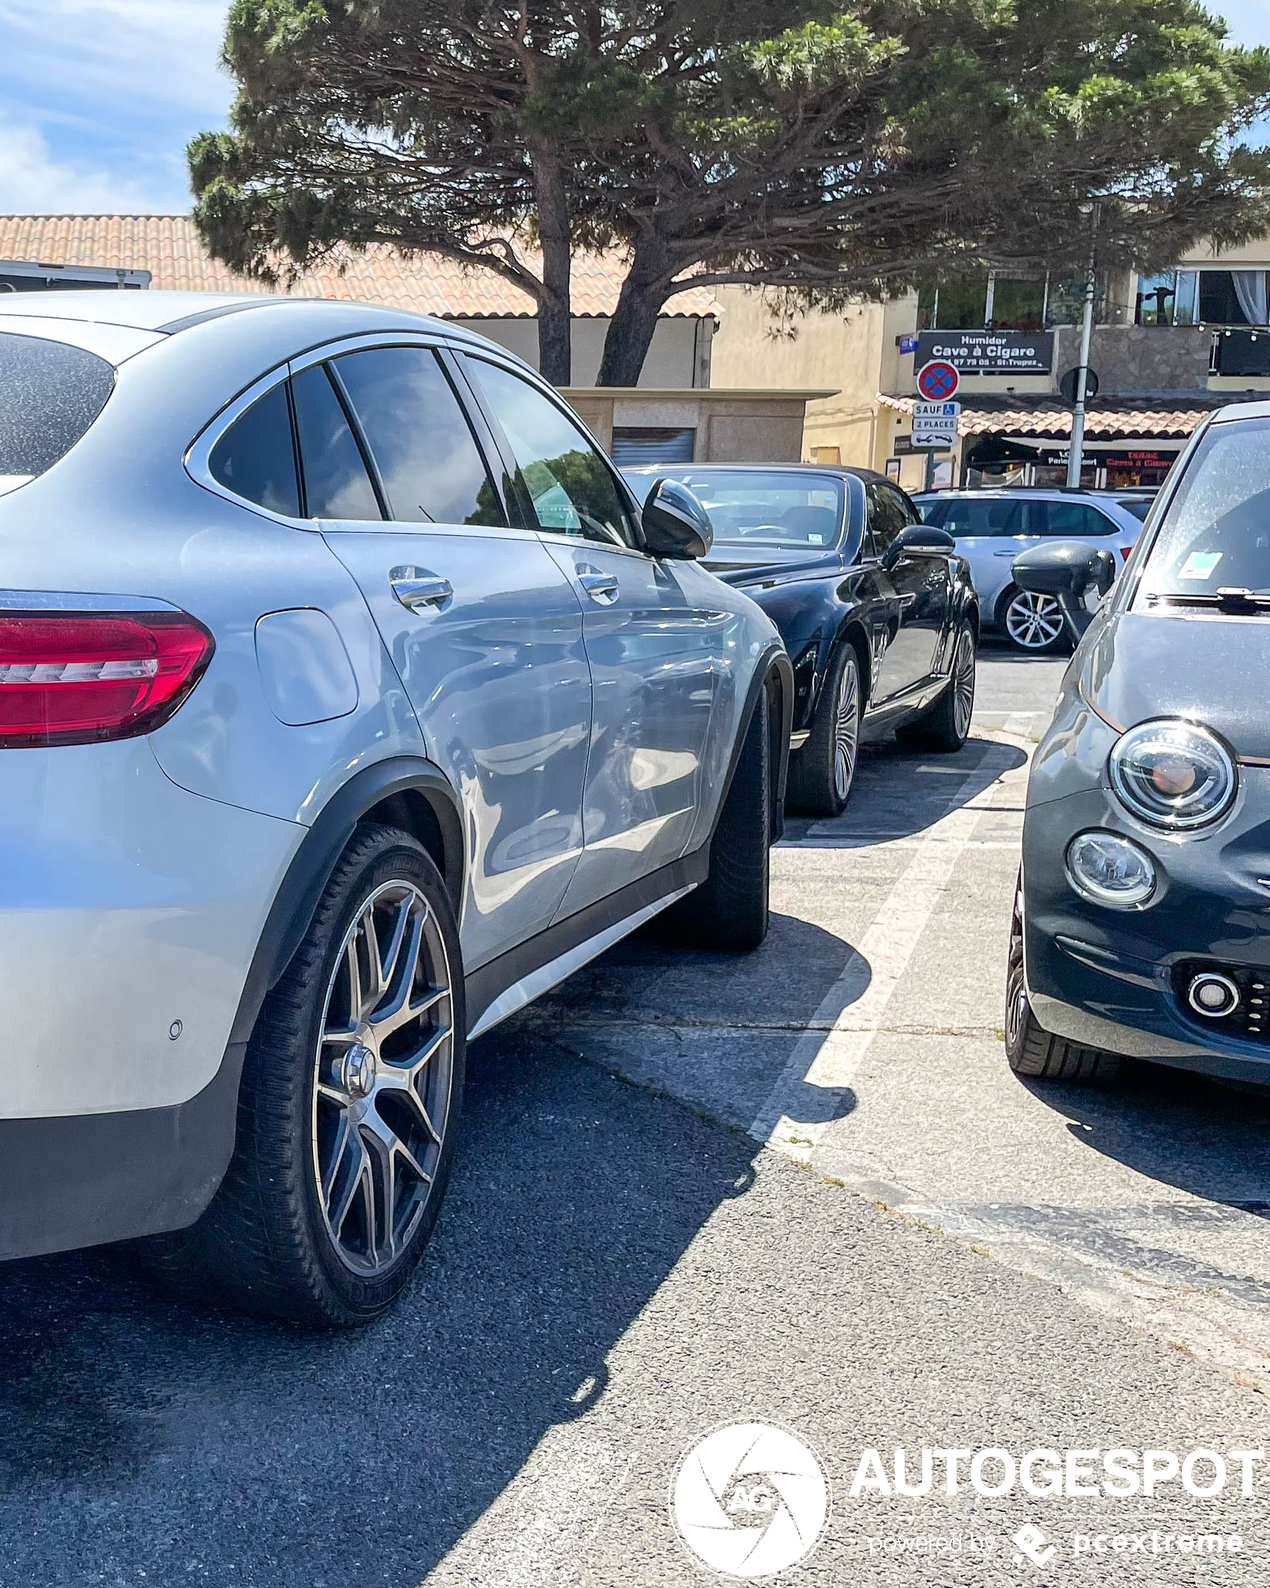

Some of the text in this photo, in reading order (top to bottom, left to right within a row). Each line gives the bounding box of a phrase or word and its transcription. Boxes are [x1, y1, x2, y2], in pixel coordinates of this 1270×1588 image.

[961, 335, 1007, 345] Humidor
[932, 345, 1035, 359] Cave à Cigare
[916, 405, 942, 414] SAUF
